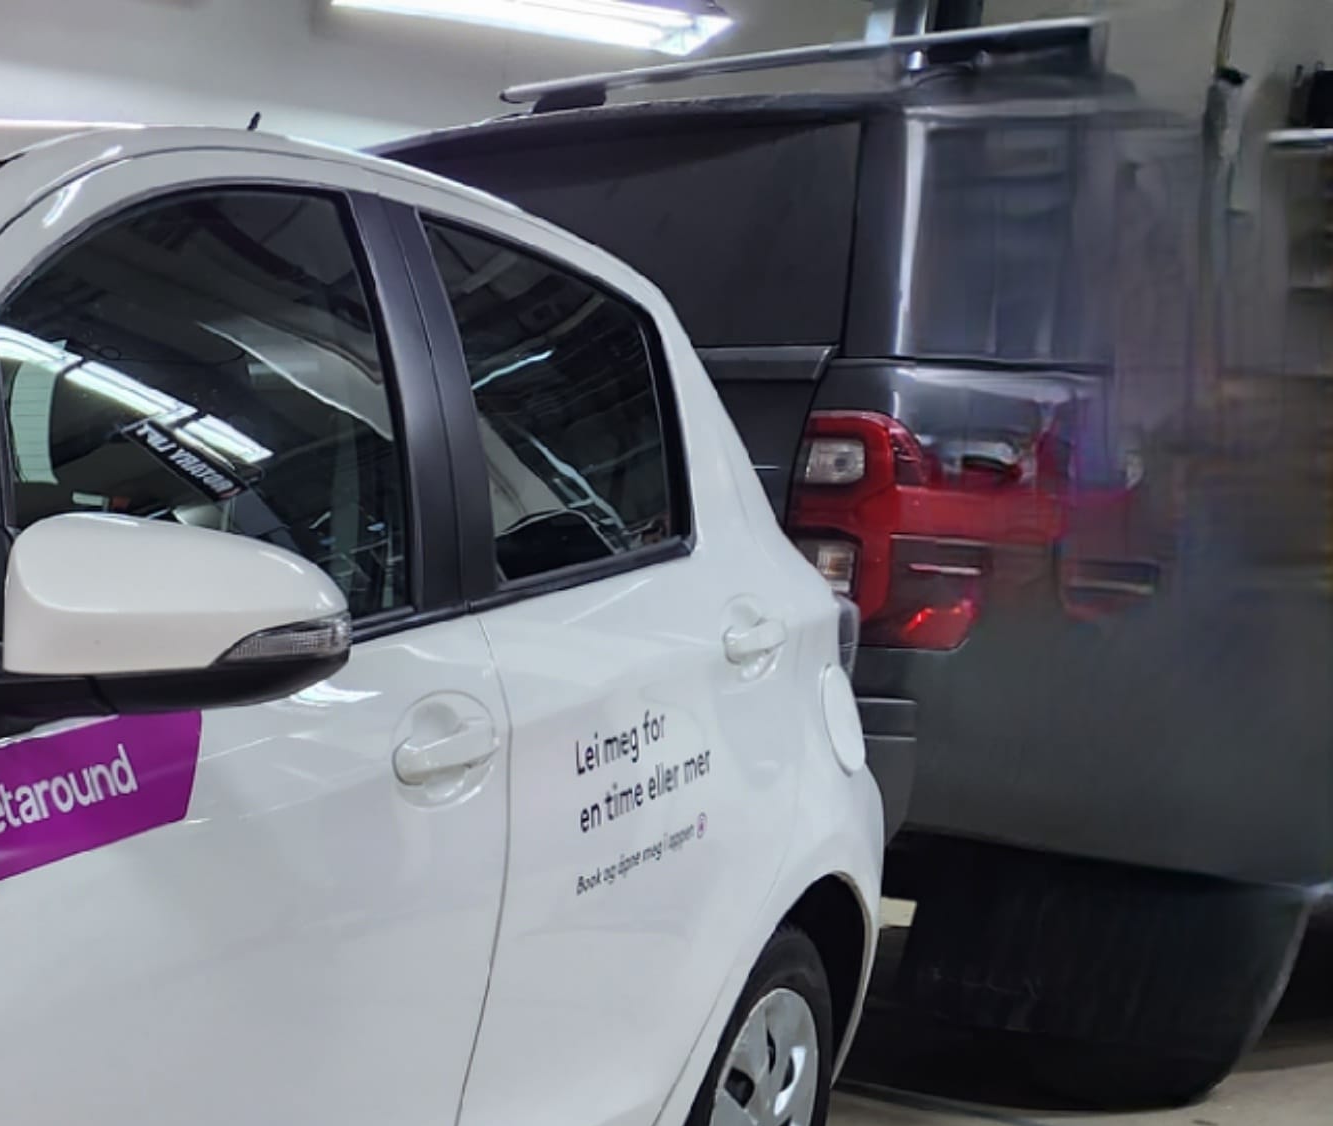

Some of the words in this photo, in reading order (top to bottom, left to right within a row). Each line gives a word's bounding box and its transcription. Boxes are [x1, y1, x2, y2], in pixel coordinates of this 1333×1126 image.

[575, 732, 600, 776] Lei
[603, 726, 640, 763] meg
[642, 710, 665, 745] for
[580, 801, 601, 833] en
[604, 782, 643, 821] time
[647, 763, 679, 800] eller
[683, 750, 710, 784] mer
